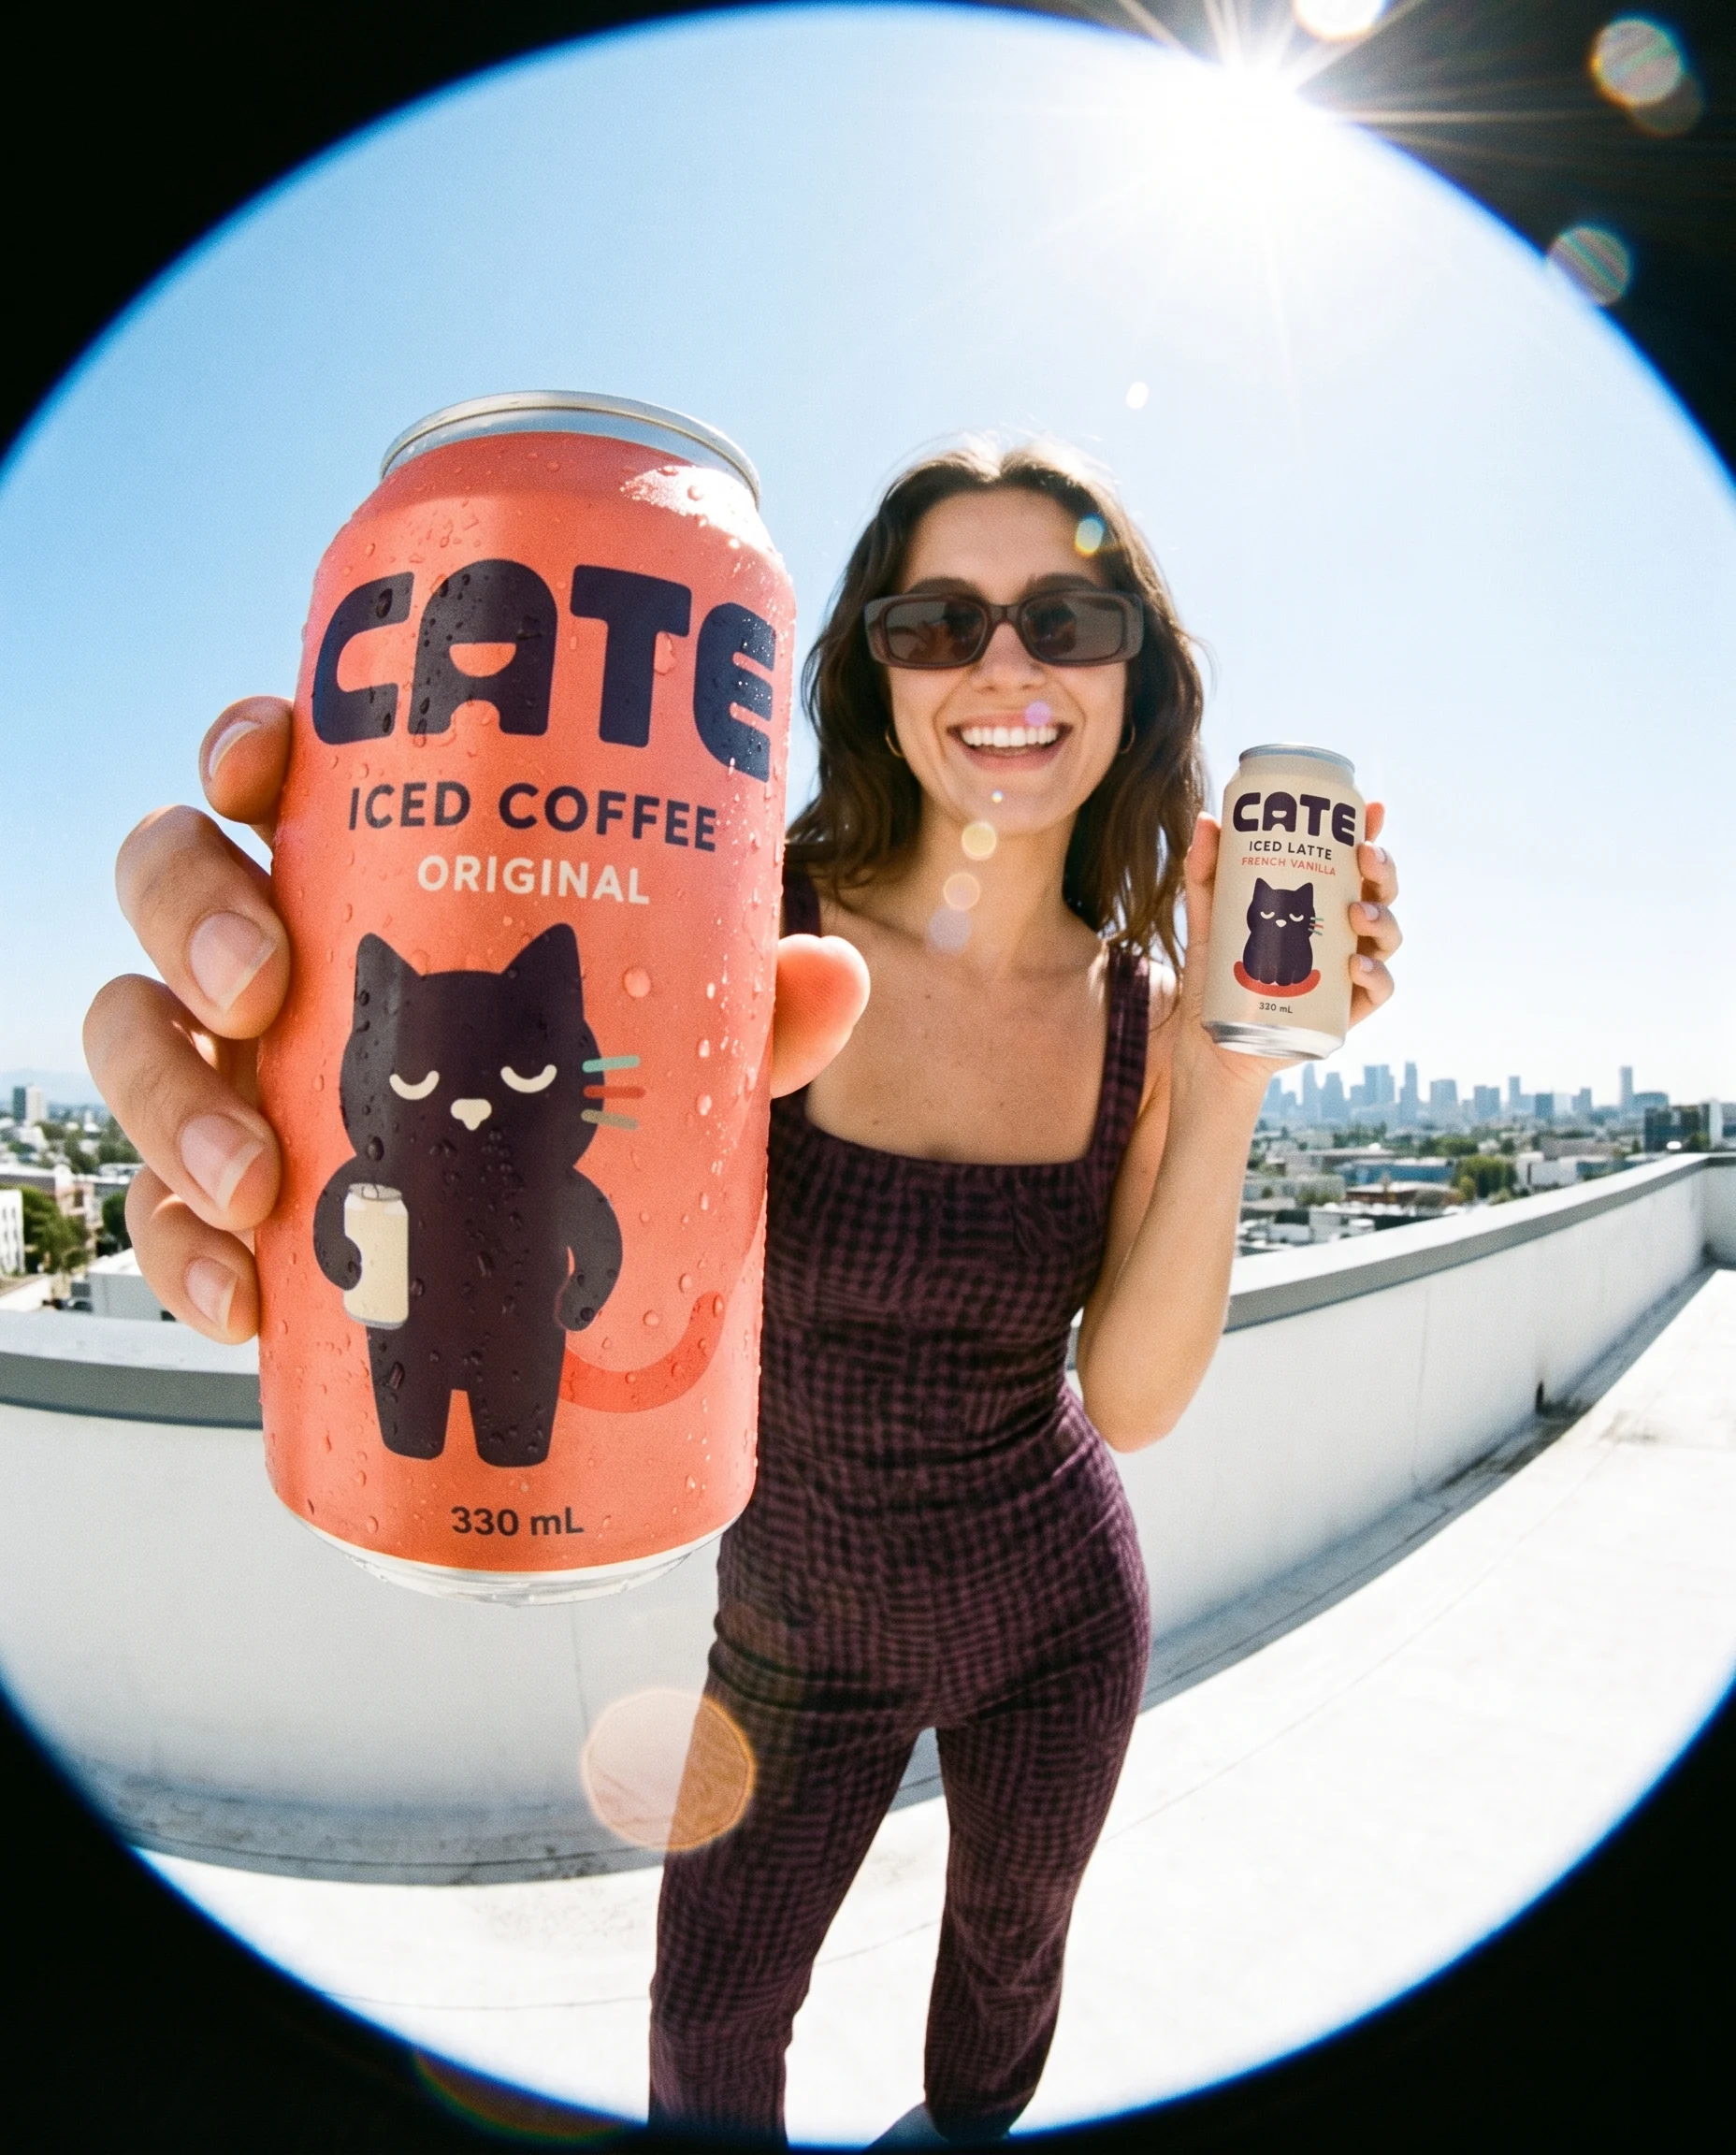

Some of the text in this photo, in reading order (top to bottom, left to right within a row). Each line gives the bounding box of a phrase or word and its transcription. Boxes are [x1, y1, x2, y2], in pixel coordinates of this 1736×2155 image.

[312, 558, 775, 782] CATE
[349, 781, 716, 852] ICED COFFEE
[1233, 791, 1355, 846] CATE
[1241, 857, 1336, 876] FRENCH VANILLA
[1249, 840, 1332, 860] ICED LATTE
[417, 855, 650, 904] ORIGINAL
[1280, 1005, 1293, 1014] mL
[451, 1506, 585, 1537] 330 mL
